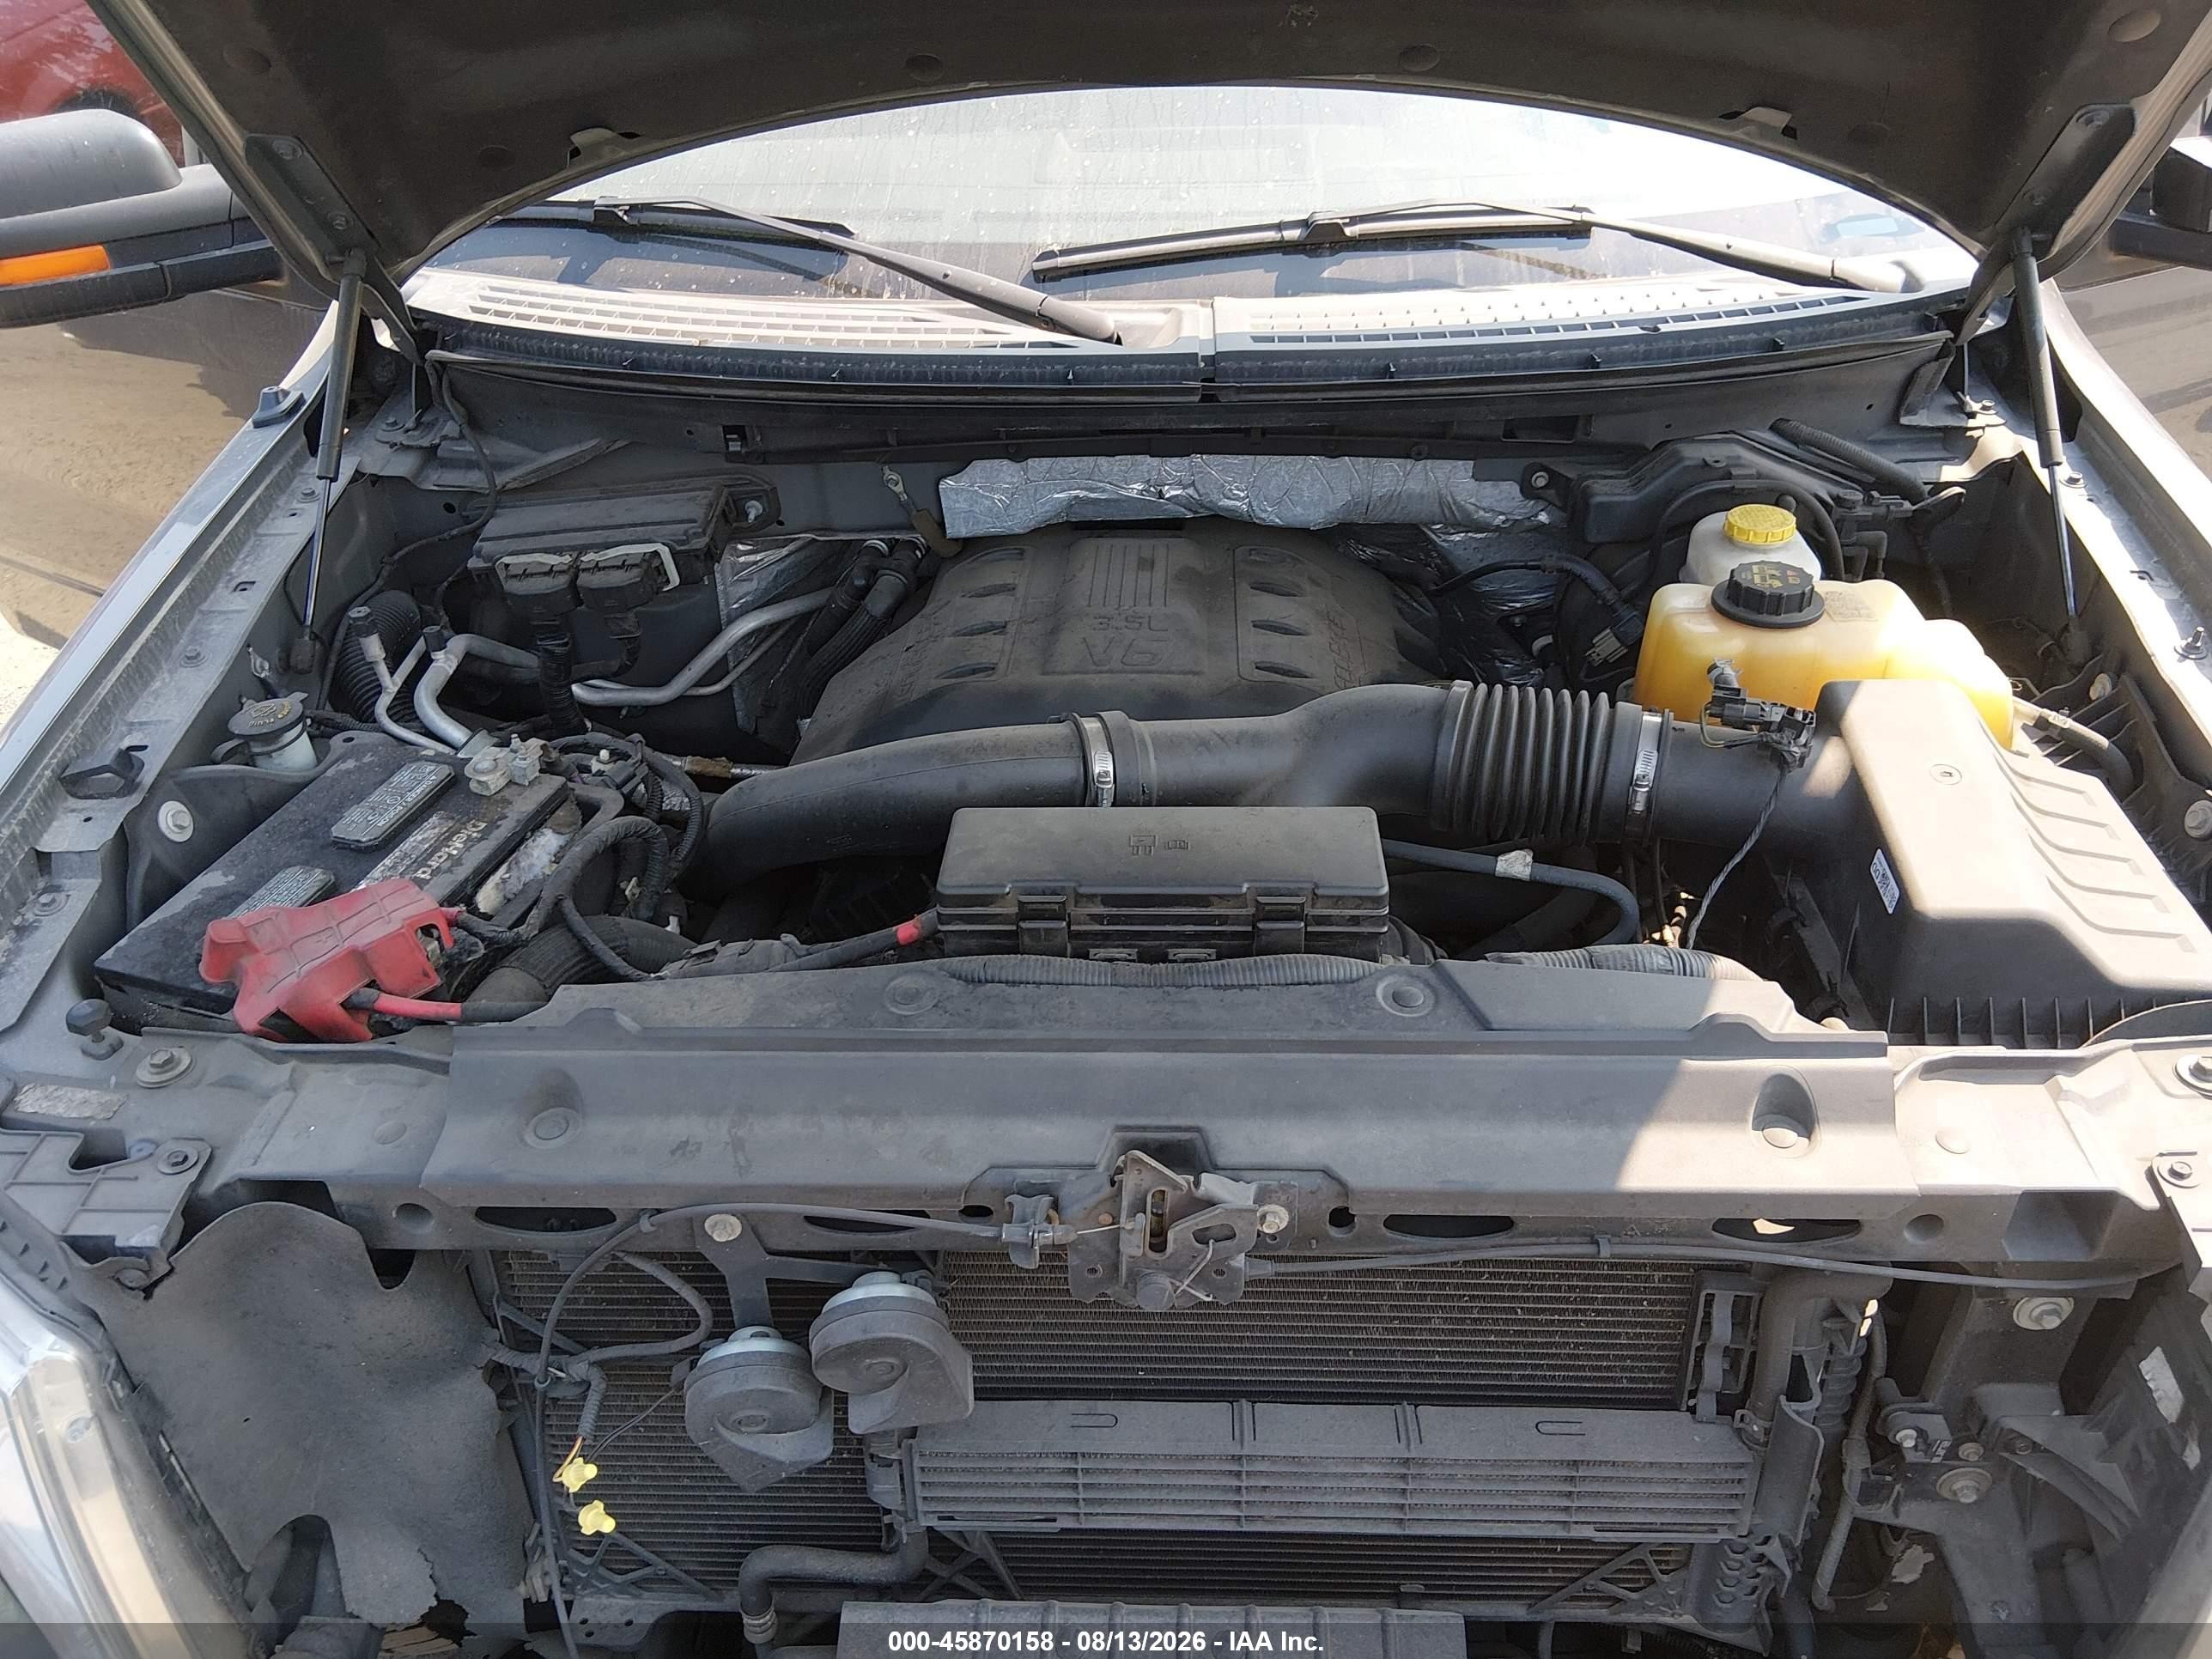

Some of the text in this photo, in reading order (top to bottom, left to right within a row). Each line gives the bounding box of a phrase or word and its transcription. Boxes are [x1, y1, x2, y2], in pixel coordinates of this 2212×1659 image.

[1091, 615, 1169, 632] 3.5L
[1081, 635, 1170, 667] V6
[412, 819, 489, 880] DieHard
